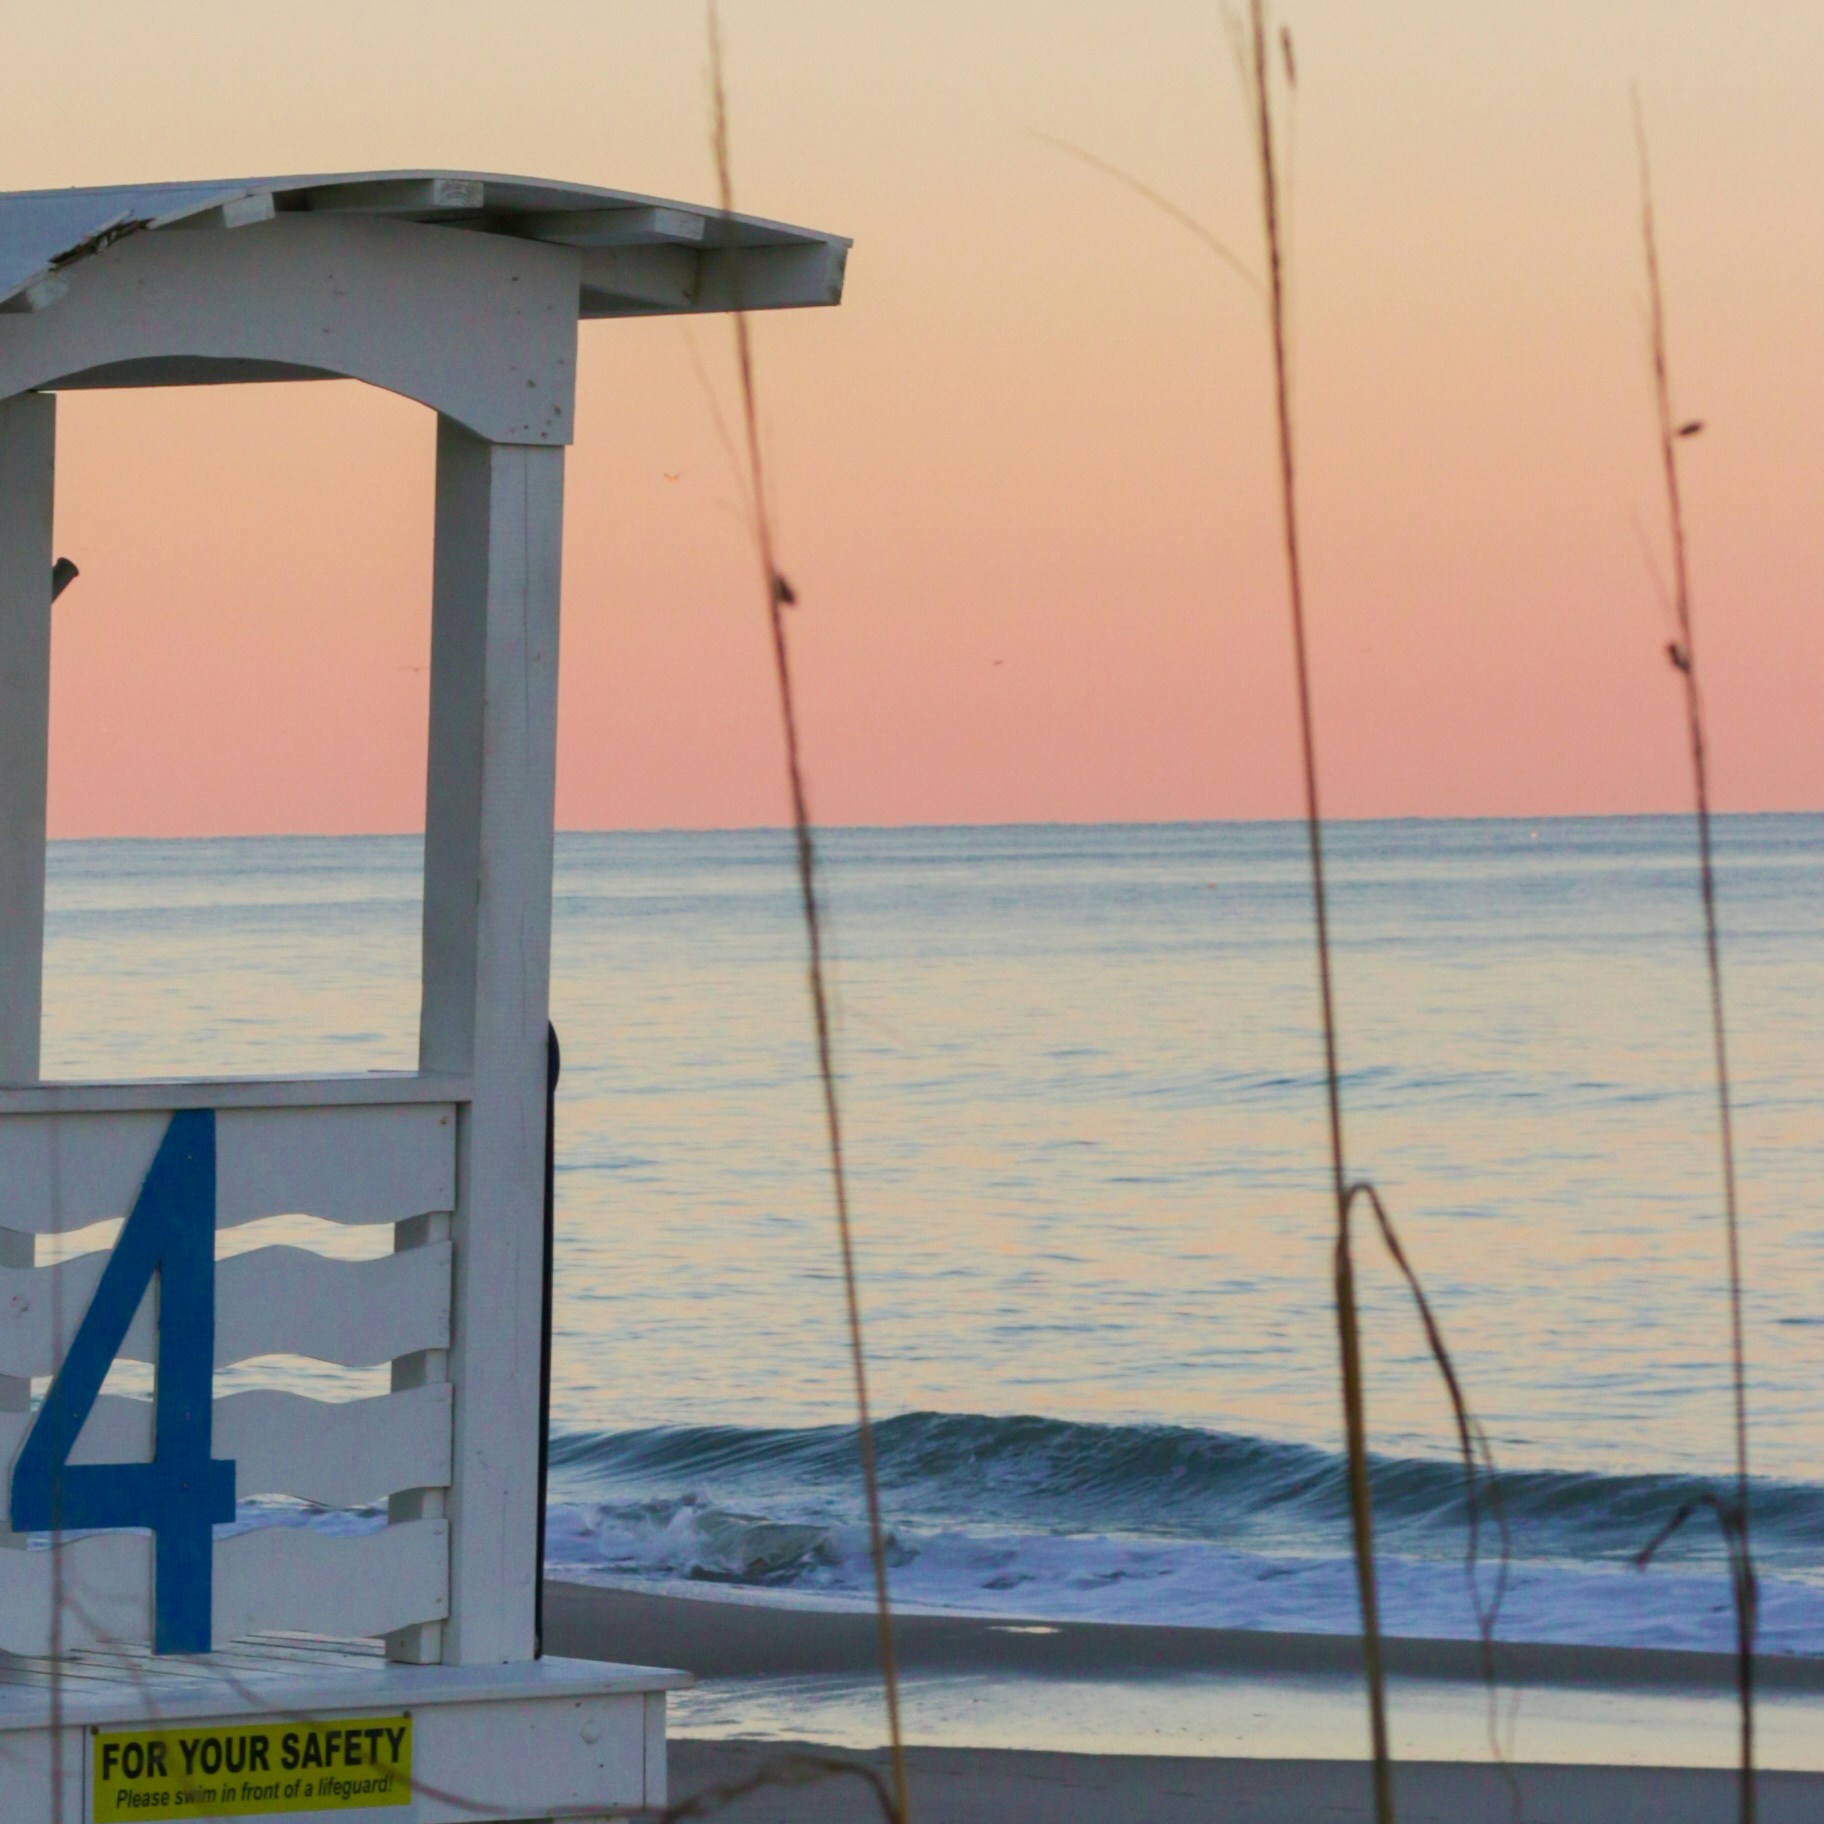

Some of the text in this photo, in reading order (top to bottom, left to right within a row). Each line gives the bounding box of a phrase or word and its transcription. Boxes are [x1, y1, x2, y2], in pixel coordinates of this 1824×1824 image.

[10, 1108, 236, 1654] 4
[102, 1727, 406, 1780] FOR YOUR SAFETY
[116, 1773, 393, 1809] Please swim in front of a lifeguard!
